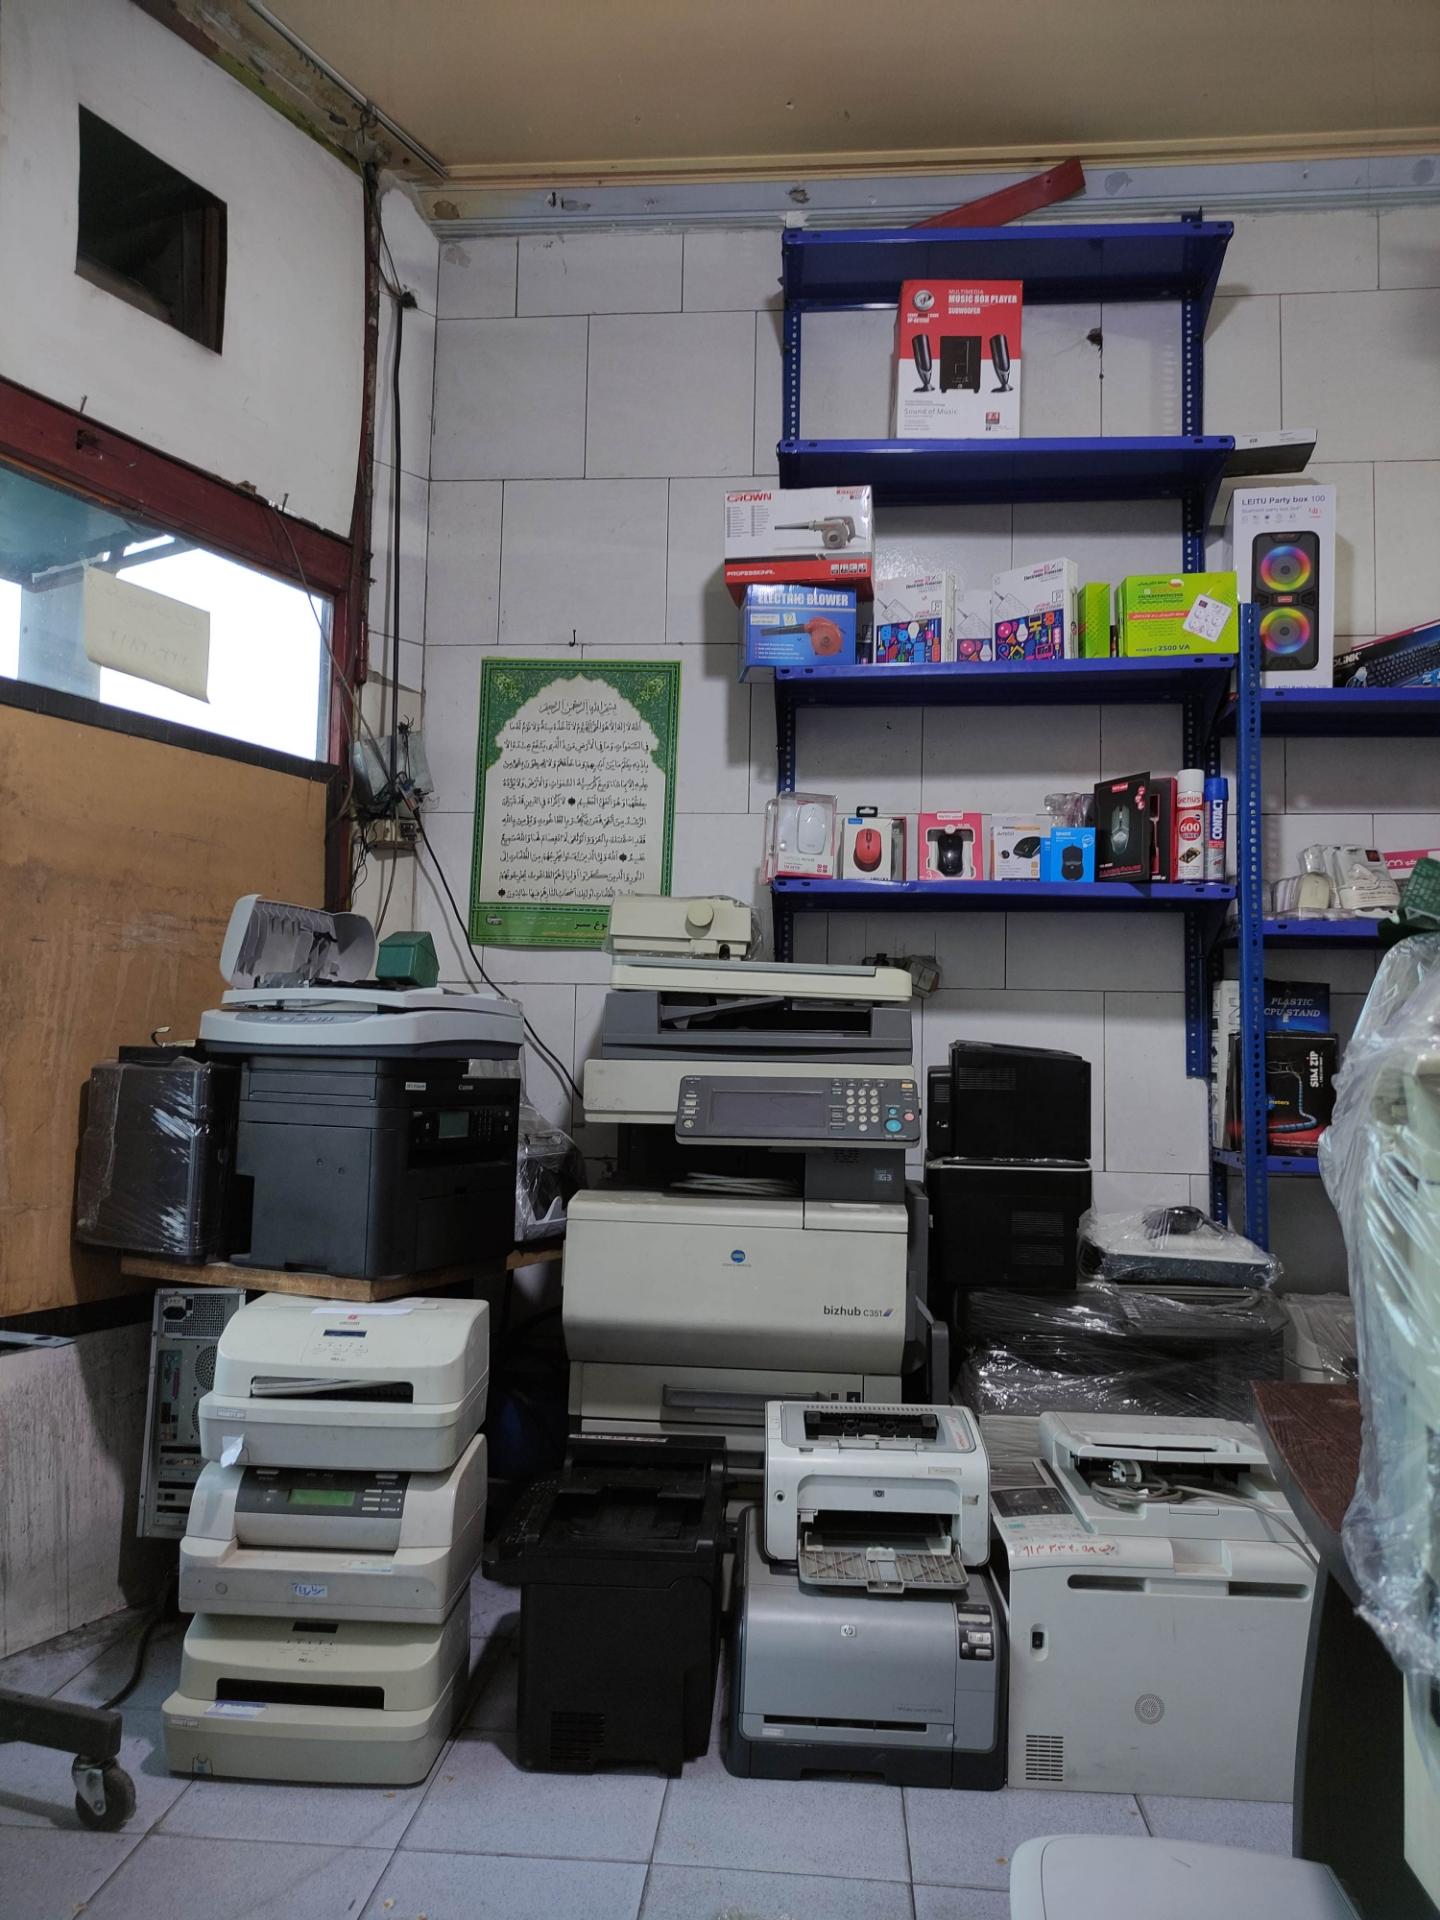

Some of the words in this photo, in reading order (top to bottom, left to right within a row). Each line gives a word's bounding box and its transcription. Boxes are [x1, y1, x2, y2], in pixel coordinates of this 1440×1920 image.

[948, 295, 974, 304] MUSIC
[974, 295, 990, 304] BOX
[990, 295, 1018, 304] PLAYER
[727, 492, 772, 503] CROWN
[1242, 498, 1267, 506] LEITU
[1269, 497, 1291, 505] Party
[757, 591, 805, 605] ELECTRIC
[806, 592, 849, 607] BLOWER
[1180, 823, 1201, 833] 600
[1271, 998, 1314, 1006] PLASTIC
[1263, 1007, 1284, 1016] CPU
[1285, 1009, 1321, 1017] STAND
[1310, 1068, 1319, 1088] SIM
[823, 1305, 861, 1316] bizhub
[863, 1309, 882, 1317] C351
